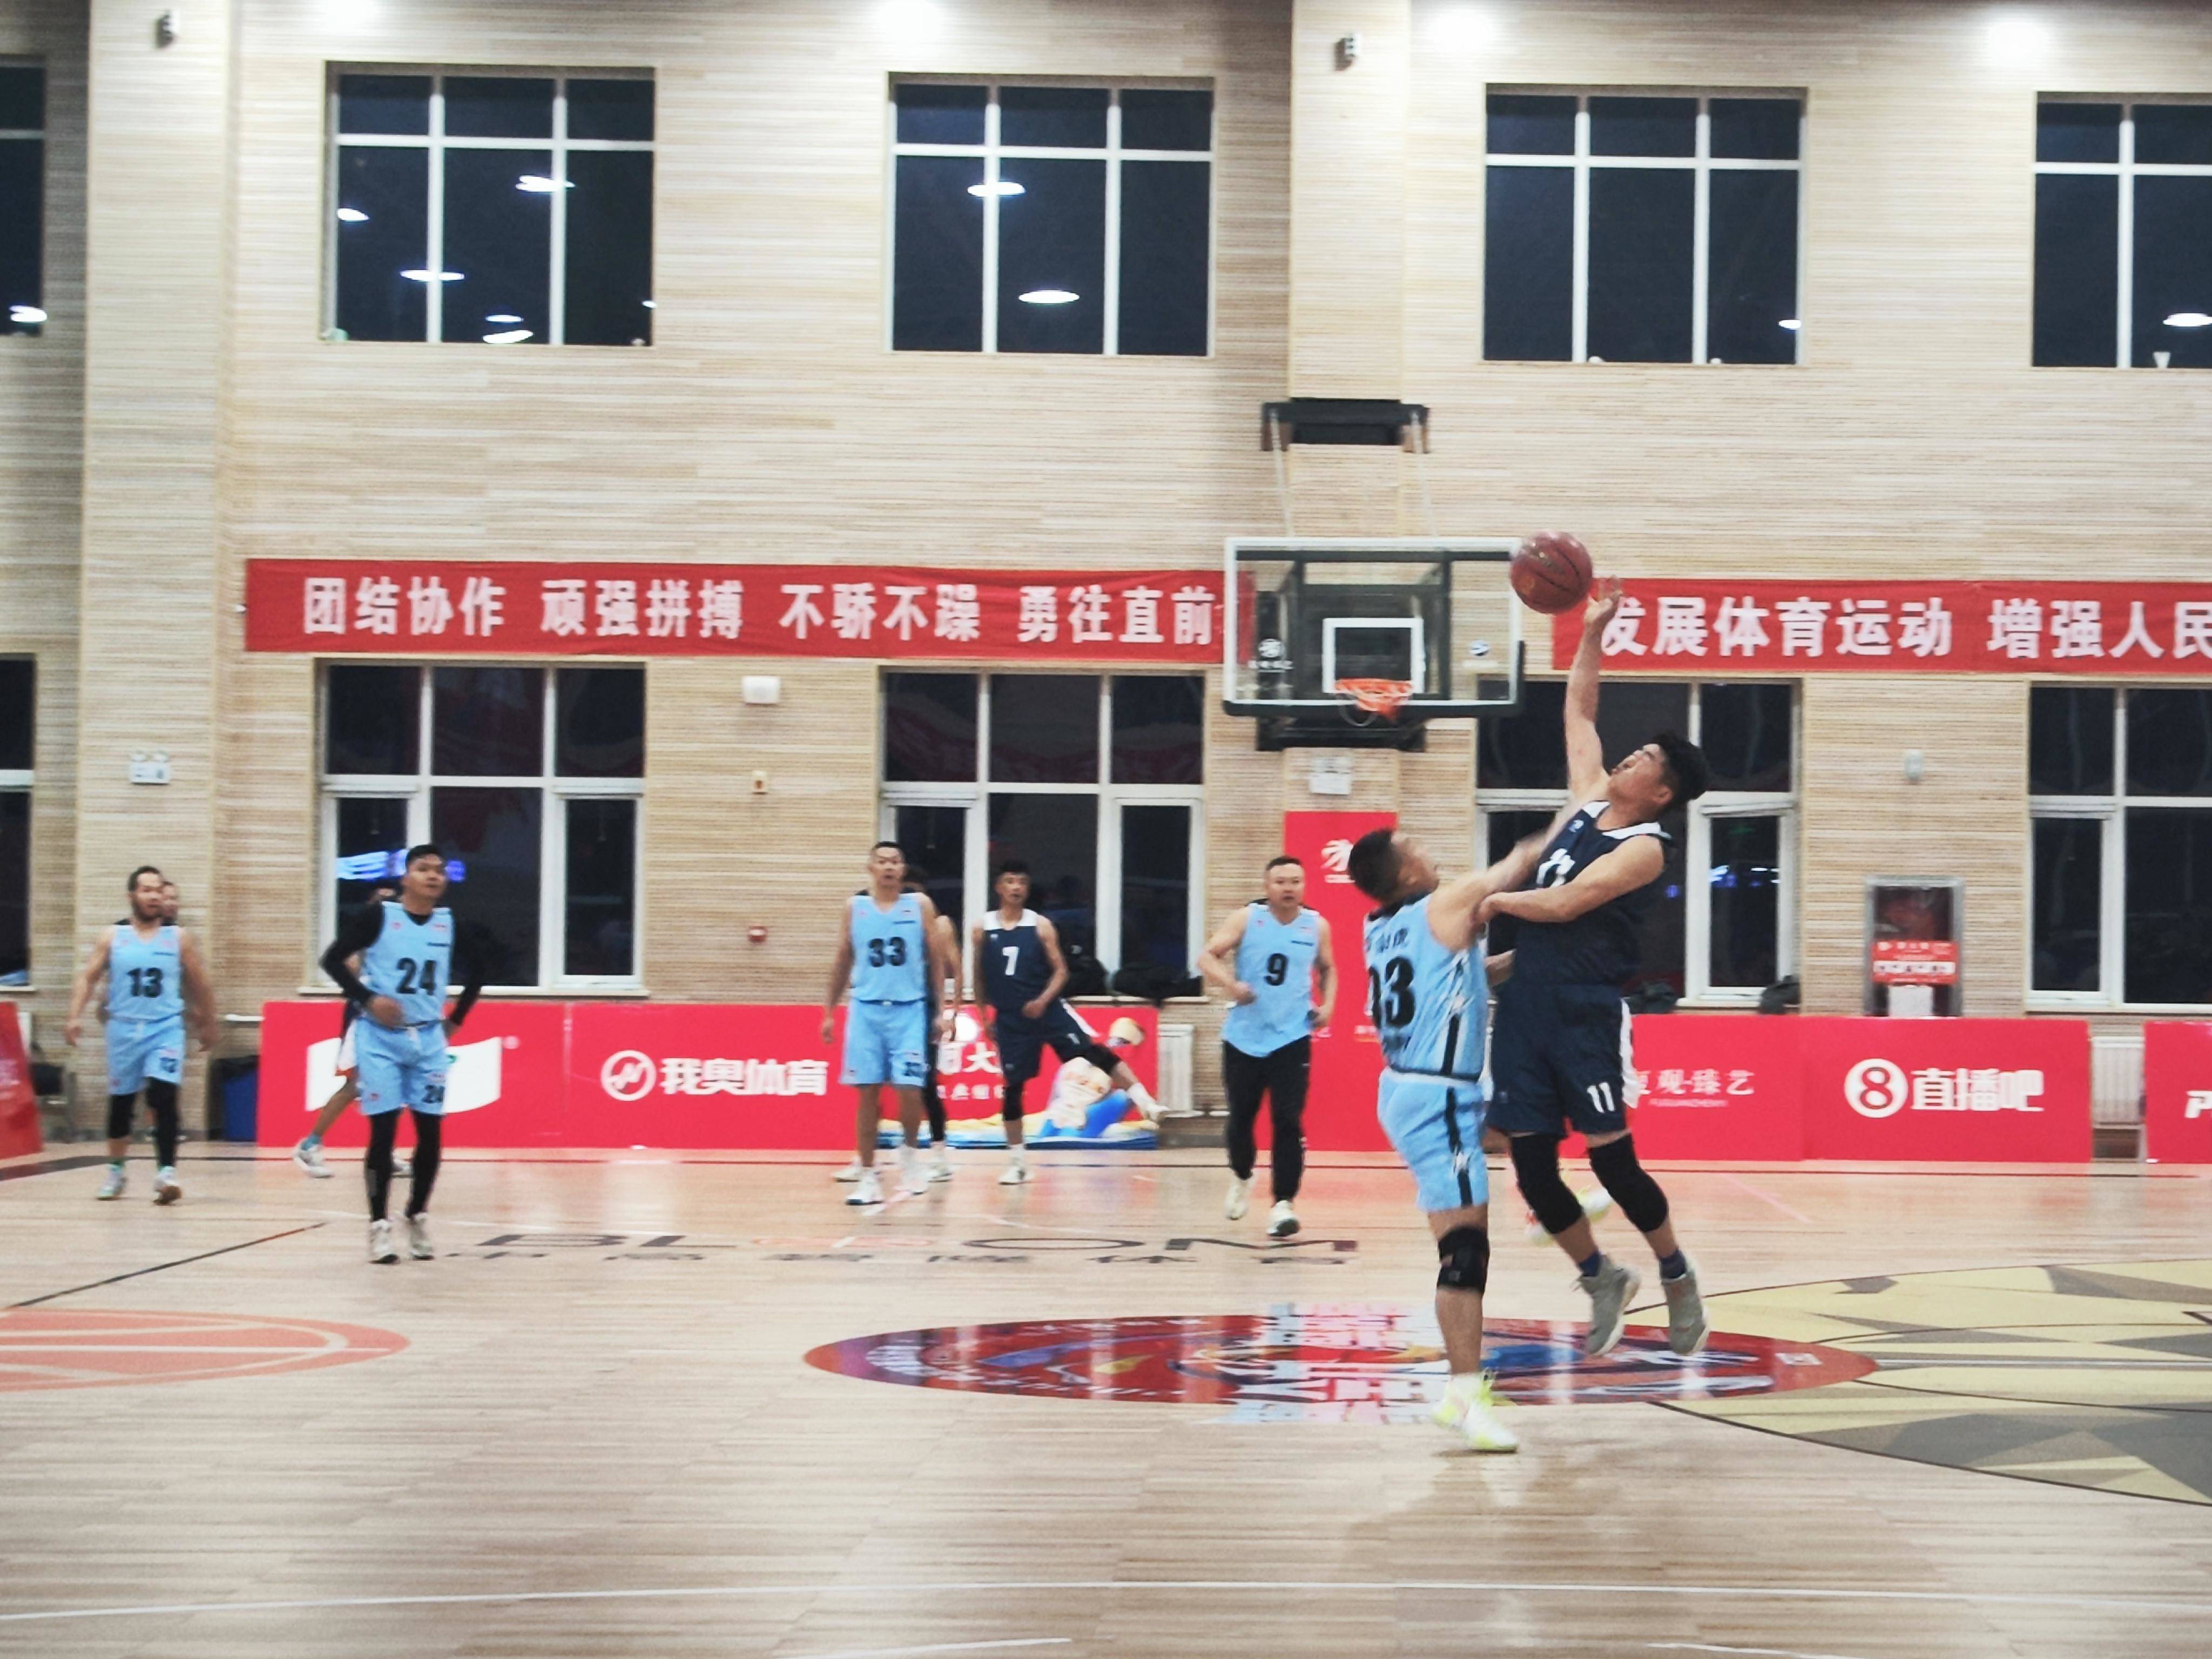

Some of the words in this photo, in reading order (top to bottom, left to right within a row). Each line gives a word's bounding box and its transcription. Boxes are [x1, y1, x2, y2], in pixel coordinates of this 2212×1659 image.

[304, 576, 506, 637] 团结协作
[541, 579, 743, 639] 顽强拼搏
[779, 582, 980, 642] 不骄不躁
[1017, 584, 1216, 645] 勇往直前
[1600, 596, 1952, 657] 发展体育运动
[1986, 598, 2212, 659] 增强人民
[869, 936, 906, 967] 33
[127, 967, 164, 998] 13
[396, 957, 439, 995] 24
[1265, 953, 1288, 987] 9
[1587, 1082, 1615, 1113] 11
[1910, 1067, 2044, 1112] 直播吧
